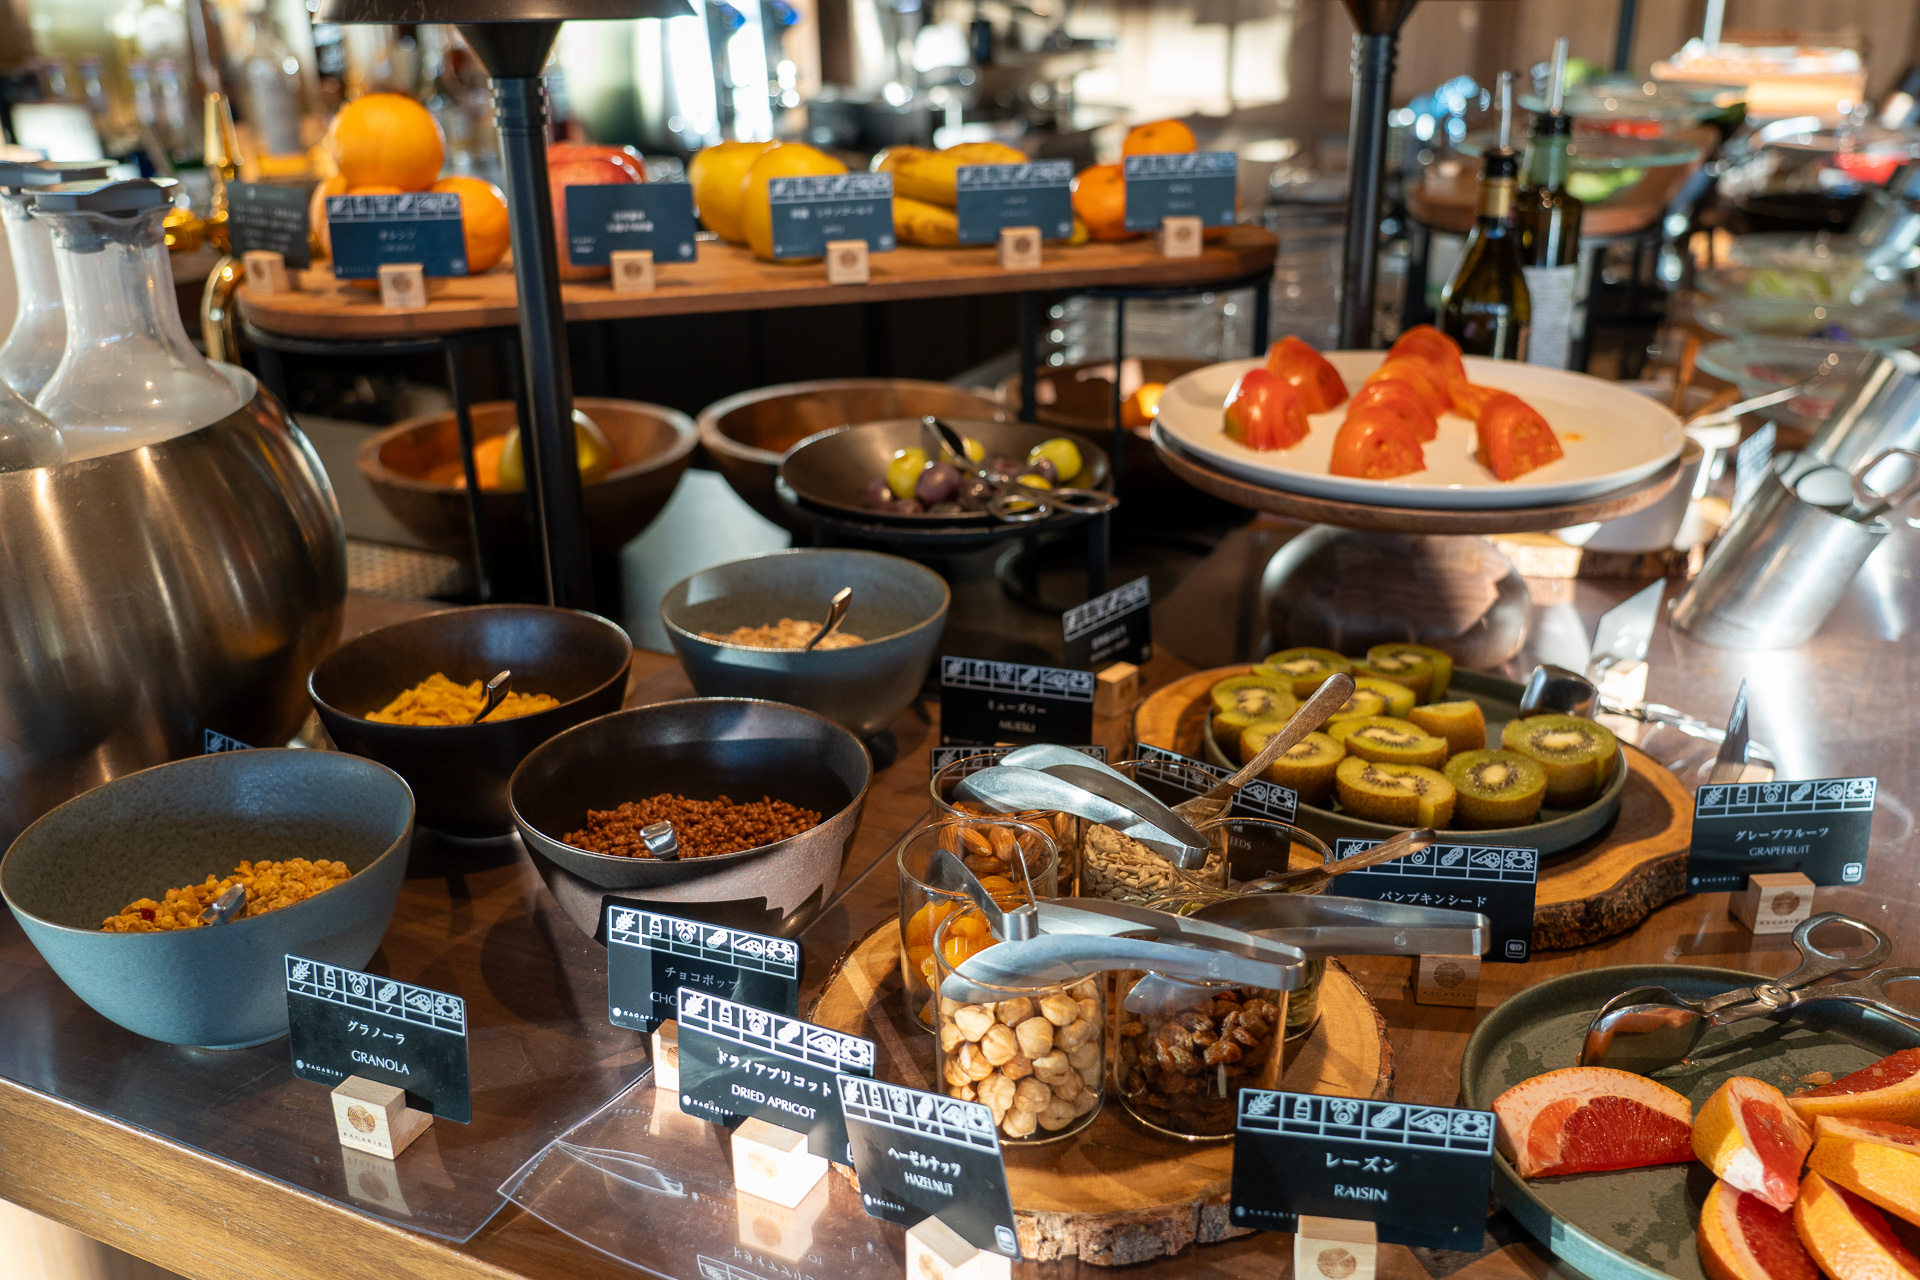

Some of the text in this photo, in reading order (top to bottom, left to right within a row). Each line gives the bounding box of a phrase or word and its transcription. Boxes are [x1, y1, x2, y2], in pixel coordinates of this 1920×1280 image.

[988, 700, 1047, 715] ミューズリー
[999, 720, 1036, 733] MUESLI
[1735, 827, 1829, 842] グレープフルーツ
[1749, 844, 1811, 857] GRAPEFRUIT
[1379, 891, 1487, 908] パンプキンシード
[1759, 918, 1803, 926] KAGARIB
[650, 991, 677, 1006] CHO
[348, 1020, 406, 1045] グラノーラ
[351, 1050, 410, 1075] GRANOLA
[718, 1050, 832, 1098] ドライアプリコット
[731, 1084, 817, 1120] DRIED APRICOT
[888, 1147, 962, 1177] ヘーゼルナッツ
[1325, 1152, 1399, 1174] レーズン
[904, 1171, 954, 1197] HAZELNUT
[1333, 1184, 1389, 1202] RAISIN
[1249, 1209, 1297, 1219] KAGARIB
